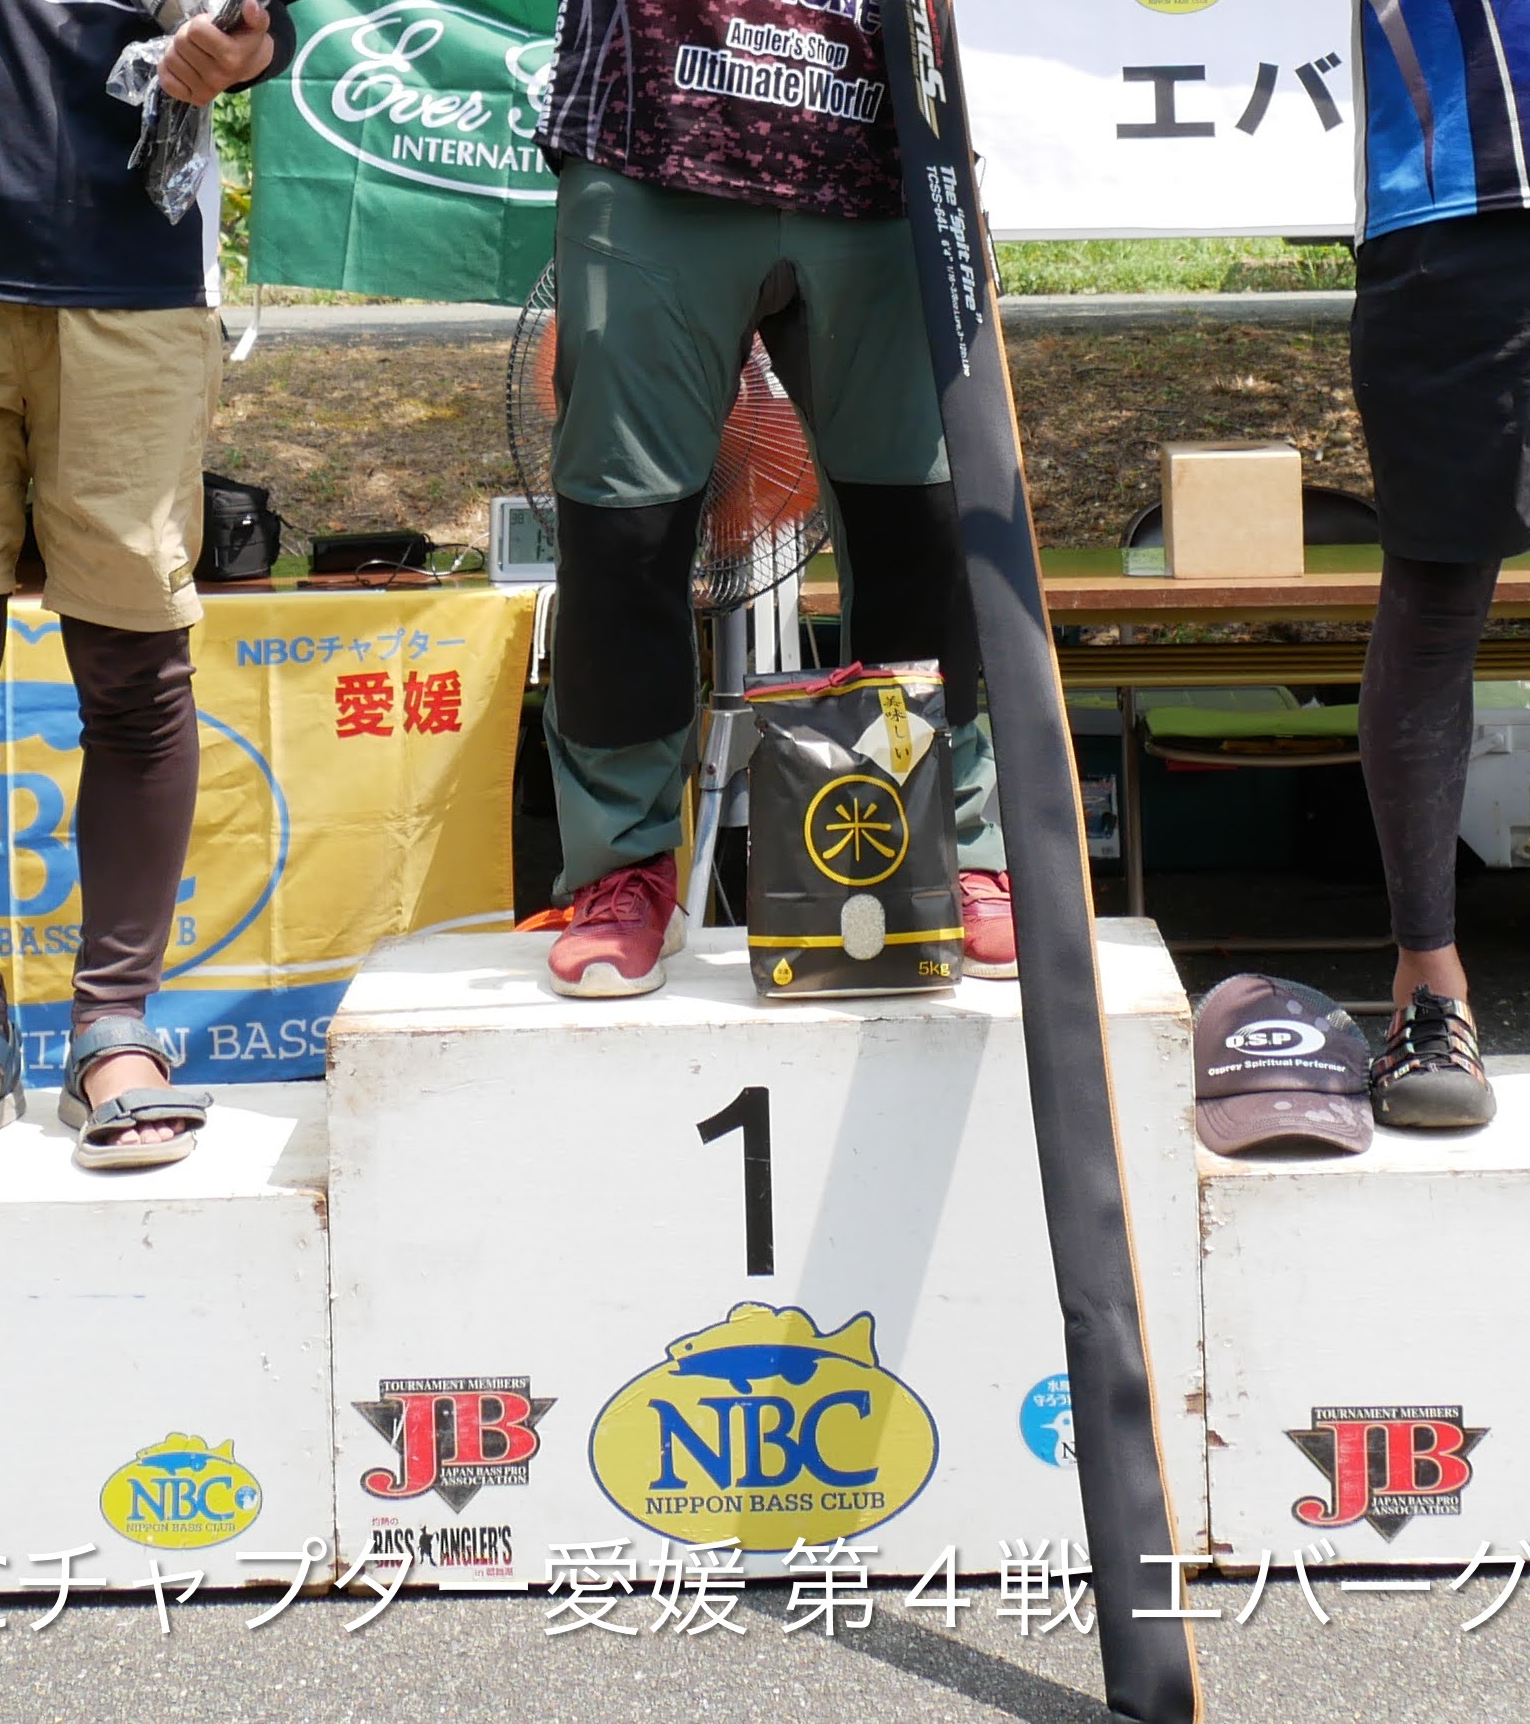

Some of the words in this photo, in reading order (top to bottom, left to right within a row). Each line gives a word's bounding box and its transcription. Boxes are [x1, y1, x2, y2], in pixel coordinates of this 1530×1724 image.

[727, 18, 804, 59] Angler's
[808, 34, 849, 70] Shop
[331, 19, 493, 133] Ever
[676, 45, 803, 106] Ultimate
[805, 67, 884, 123] World
[392, 134, 553, 174] INTERNATI
[939, 165, 958, 206] The
[236, 627, 466, 667] NBCチャプター
[335, 670, 463, 739] 愛媛
[883, 695, 910, 760] 美味しい
[822, 797, 896, 862] 米
[918, 960, 951, 977] 5kg
[1207, 1063, 1243, 1077] Osprey
[1244, 1058, 1294, 1069] Spiritual
[1295, 1058, 1347, 1074] Performer
[697, 1086, 775, 1276] 1
[383, 1380, 465, 1391] TOURNAMENT
[468, 1379, 526, 1390] MEMBERS
[1315, 1408, 1398, 1419] TOURNAMENT
[1401, 1407, 1459, 1418] MEMBERS
[365, 1391, 537, 1497] JB
[646, 1390, 879, 1492] NBC
[439, 1467, 475, 1476] JAPAN
[476, 1467, 503, 1476] BASS
[504, 1466, 527, 1476] PRO
[440, 1475, 527, 1486] ASSOCIATION
[1296, 1420, 1470, 1526] JB
[127, 1476, 235, 1521] NBC
[645, 1494, 743, 1515] NIPPON
[750, 1492, 813, 1514] BASS
[820, 1490, 886, 1511] CLUB
[1371, 1496, 1407, 1506] JAPAN
[1409, 1496, 1435, 1506] BASS
[1436, 1496, 1459, 1506] PRO
[1372, 1506, 1459, 1515] ASSOCIATION
[127, 1524, 169, 1532] NIPPON
[172, 1524, 202, 1532] BASS
[205, 1523, 236, 1532] CLUB
